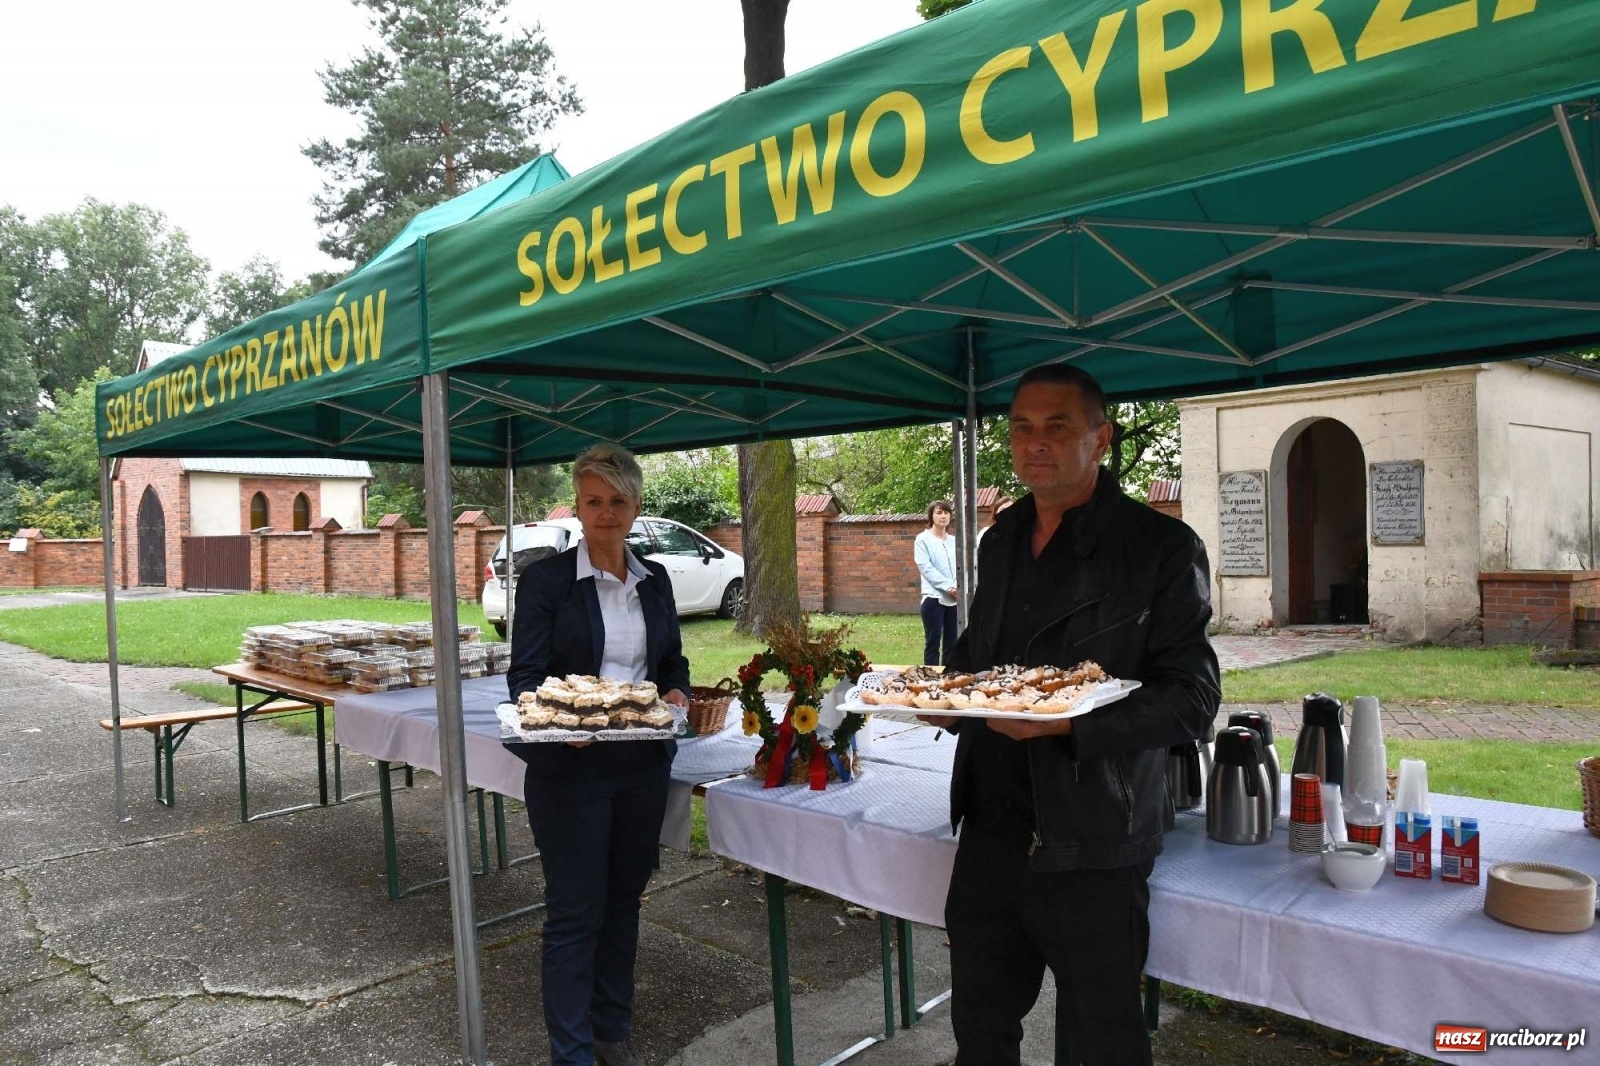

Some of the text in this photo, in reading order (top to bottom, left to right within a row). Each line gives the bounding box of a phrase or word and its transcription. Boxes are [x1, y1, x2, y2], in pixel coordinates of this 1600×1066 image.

[517, 0, 1538, 307] SOŁECTWO CYPR
[106, 288, 388, 440] SOŁECTWO CYPRZANÓW
